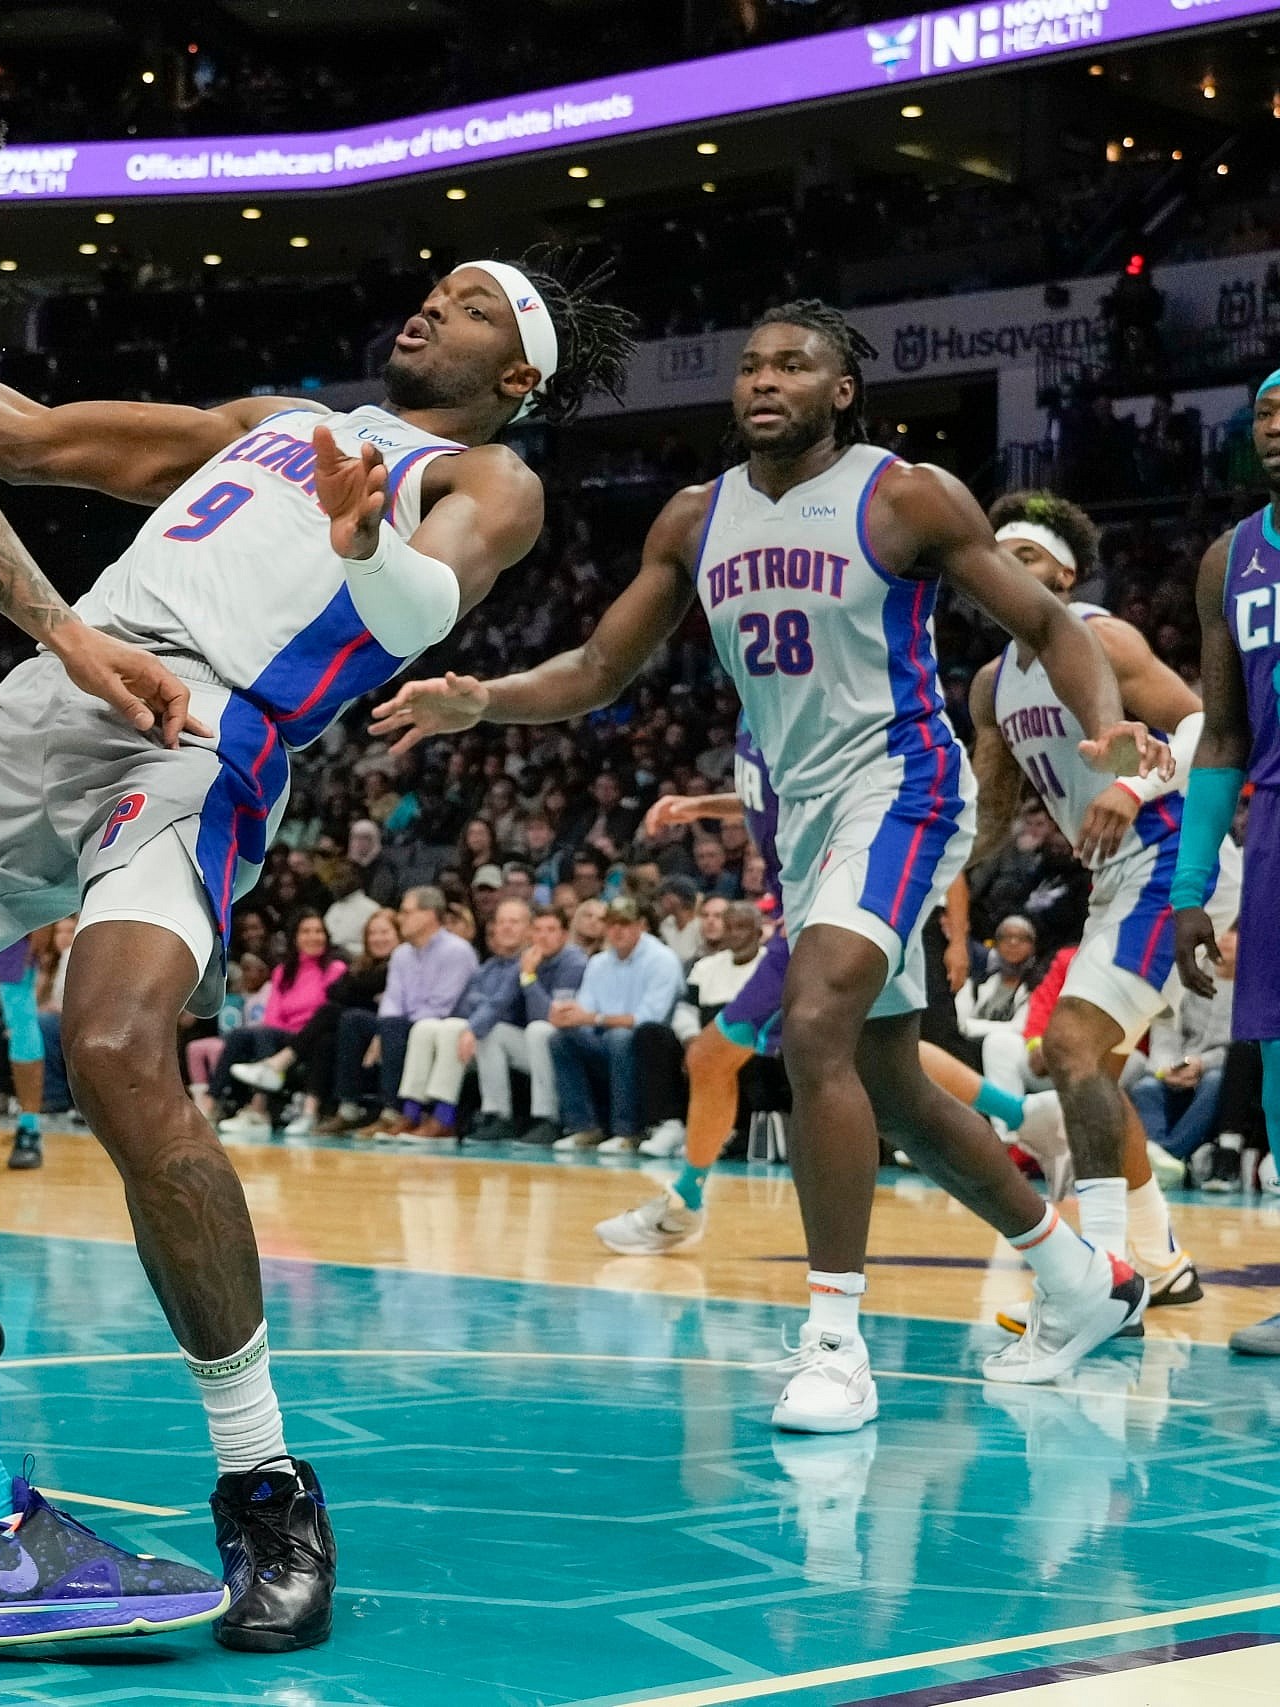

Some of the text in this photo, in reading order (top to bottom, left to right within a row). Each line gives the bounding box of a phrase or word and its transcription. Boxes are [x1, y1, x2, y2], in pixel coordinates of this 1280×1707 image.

[1003, 14, 1103, 55] HEALTH
[126, 94, 634, 181] Official Healthcare Provider of the Charlotte Hornets
[163, 481, 255, 542] 9
[802, 505, 837, 519] UWM
[707, 547, 850, 609] DETROIT
[738, 609, 815, 677] 28
[1026, 751, 1067, 798] 11
